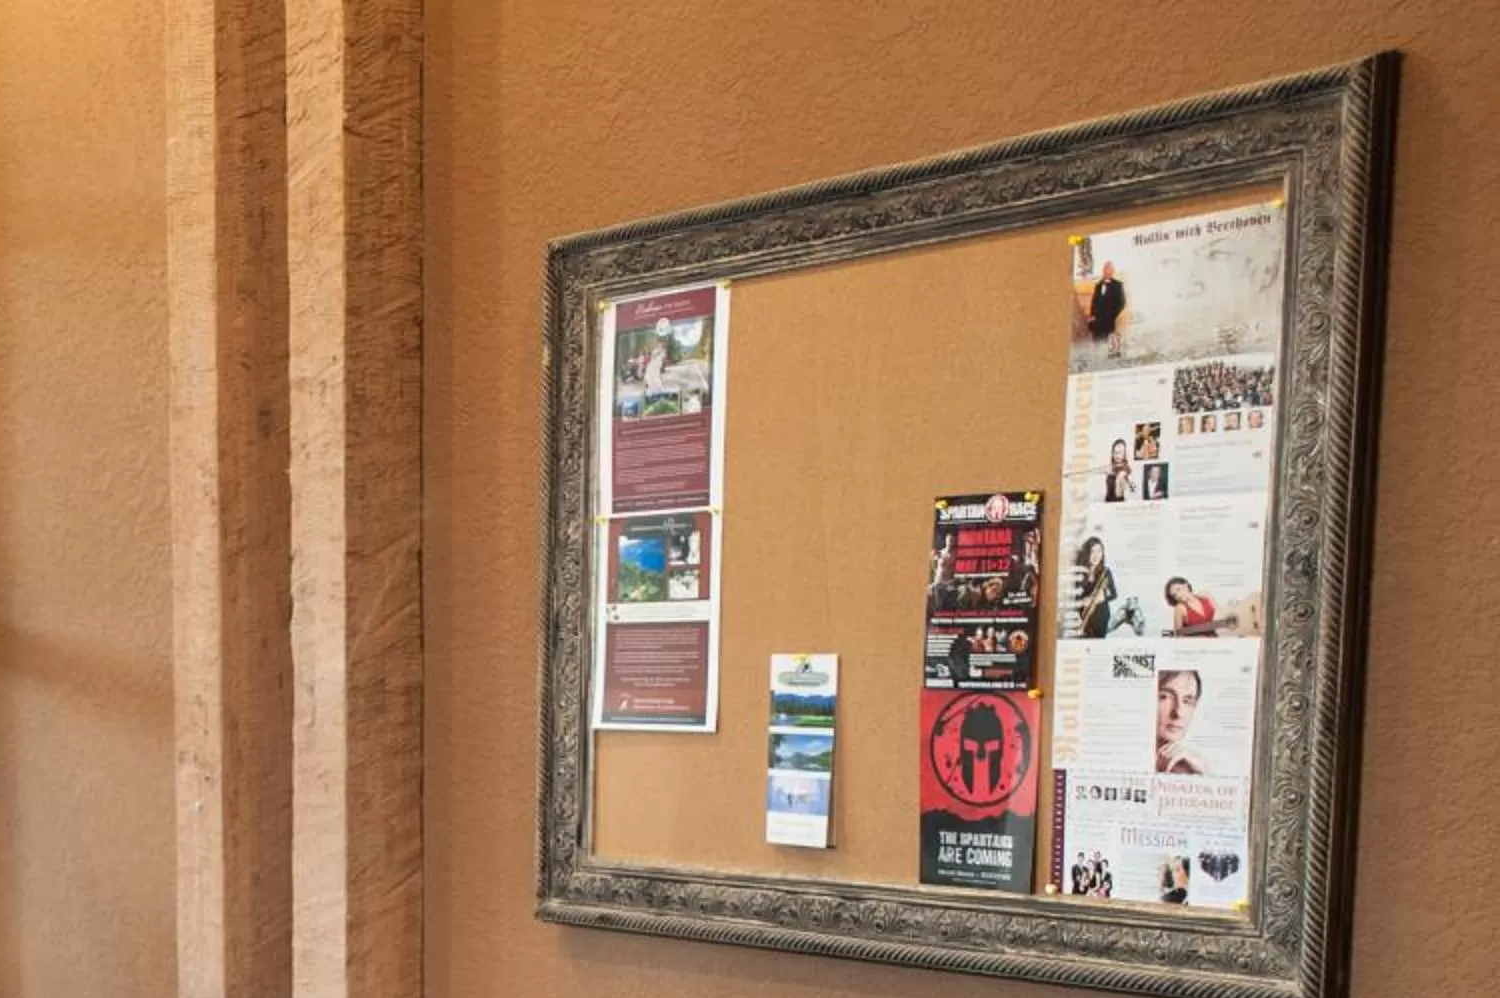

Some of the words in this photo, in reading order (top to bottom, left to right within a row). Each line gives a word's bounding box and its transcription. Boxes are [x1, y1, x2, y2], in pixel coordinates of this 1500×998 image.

[938, 831, 957, 845] THE
[959, 832, 1013, 849] SPARTANS
[937, 846, 962, 864] ARE
[965, 848, 1013, 868] COMING
